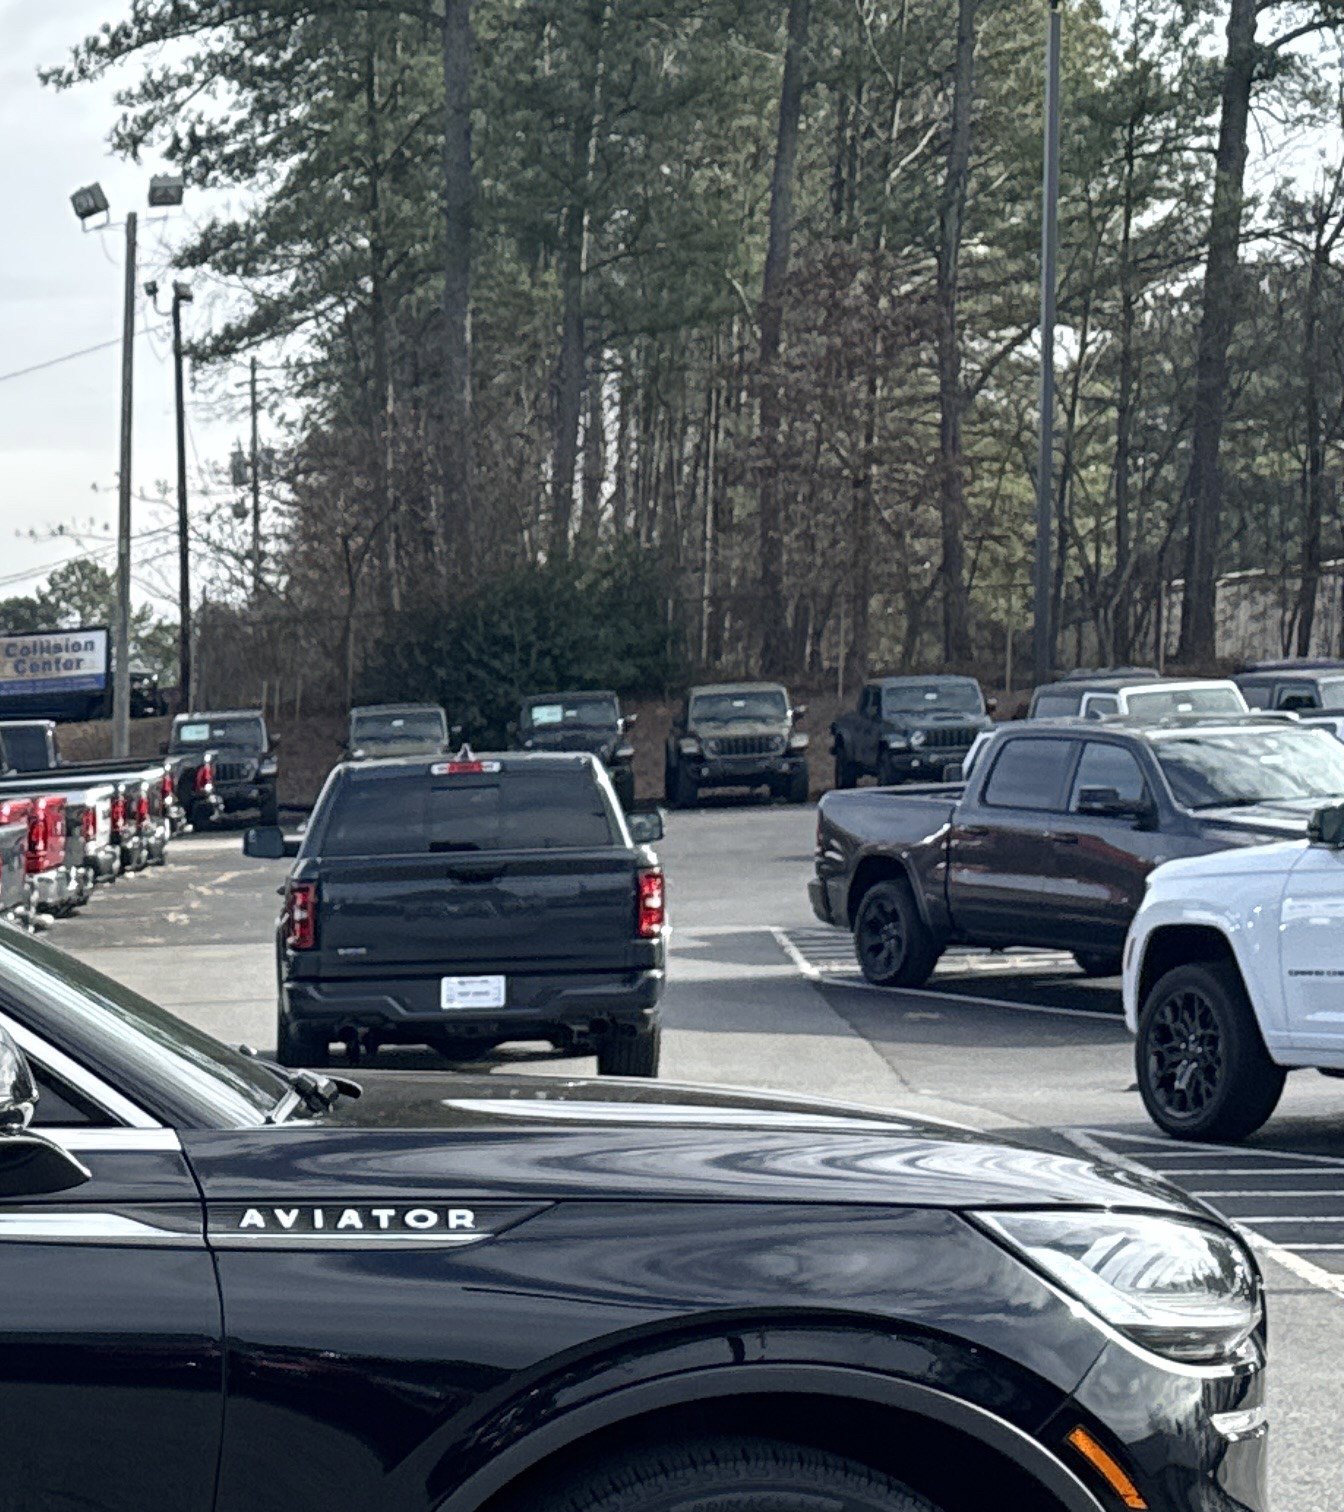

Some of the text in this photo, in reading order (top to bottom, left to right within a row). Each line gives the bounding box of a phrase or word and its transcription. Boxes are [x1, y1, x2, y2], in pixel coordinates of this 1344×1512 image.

[5, 638, 96, 658] Collision
[14, 657, 85, 675] Center
[238, 1208, 476, 1229] AVIATOR
